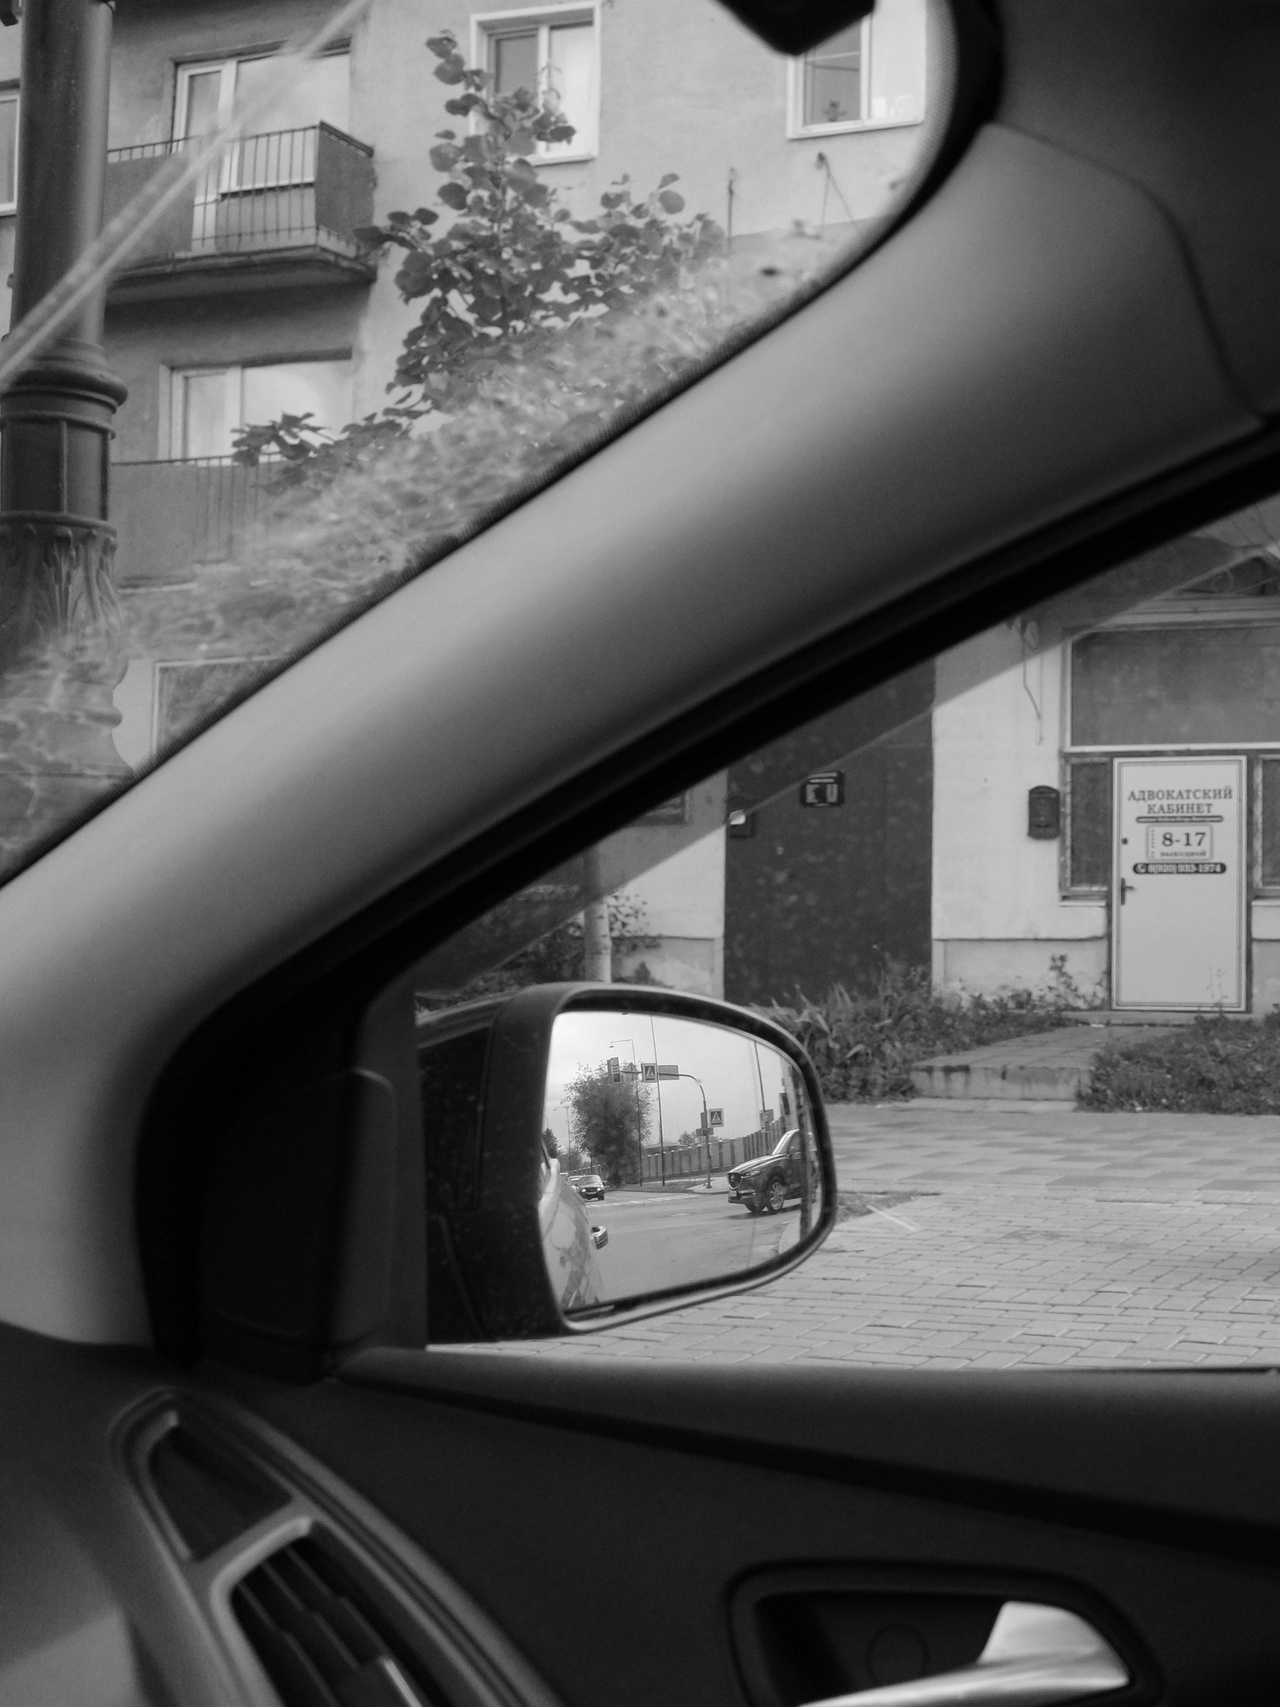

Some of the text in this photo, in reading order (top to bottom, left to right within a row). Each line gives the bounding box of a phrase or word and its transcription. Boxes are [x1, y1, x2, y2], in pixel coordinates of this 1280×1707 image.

[1128, 785, 1233, 802] АДВОКАТСКИЙ
[1146, 802, 1213, 815] КАБИНЕТ
[1161, 831, 1207, 848] 8-17
